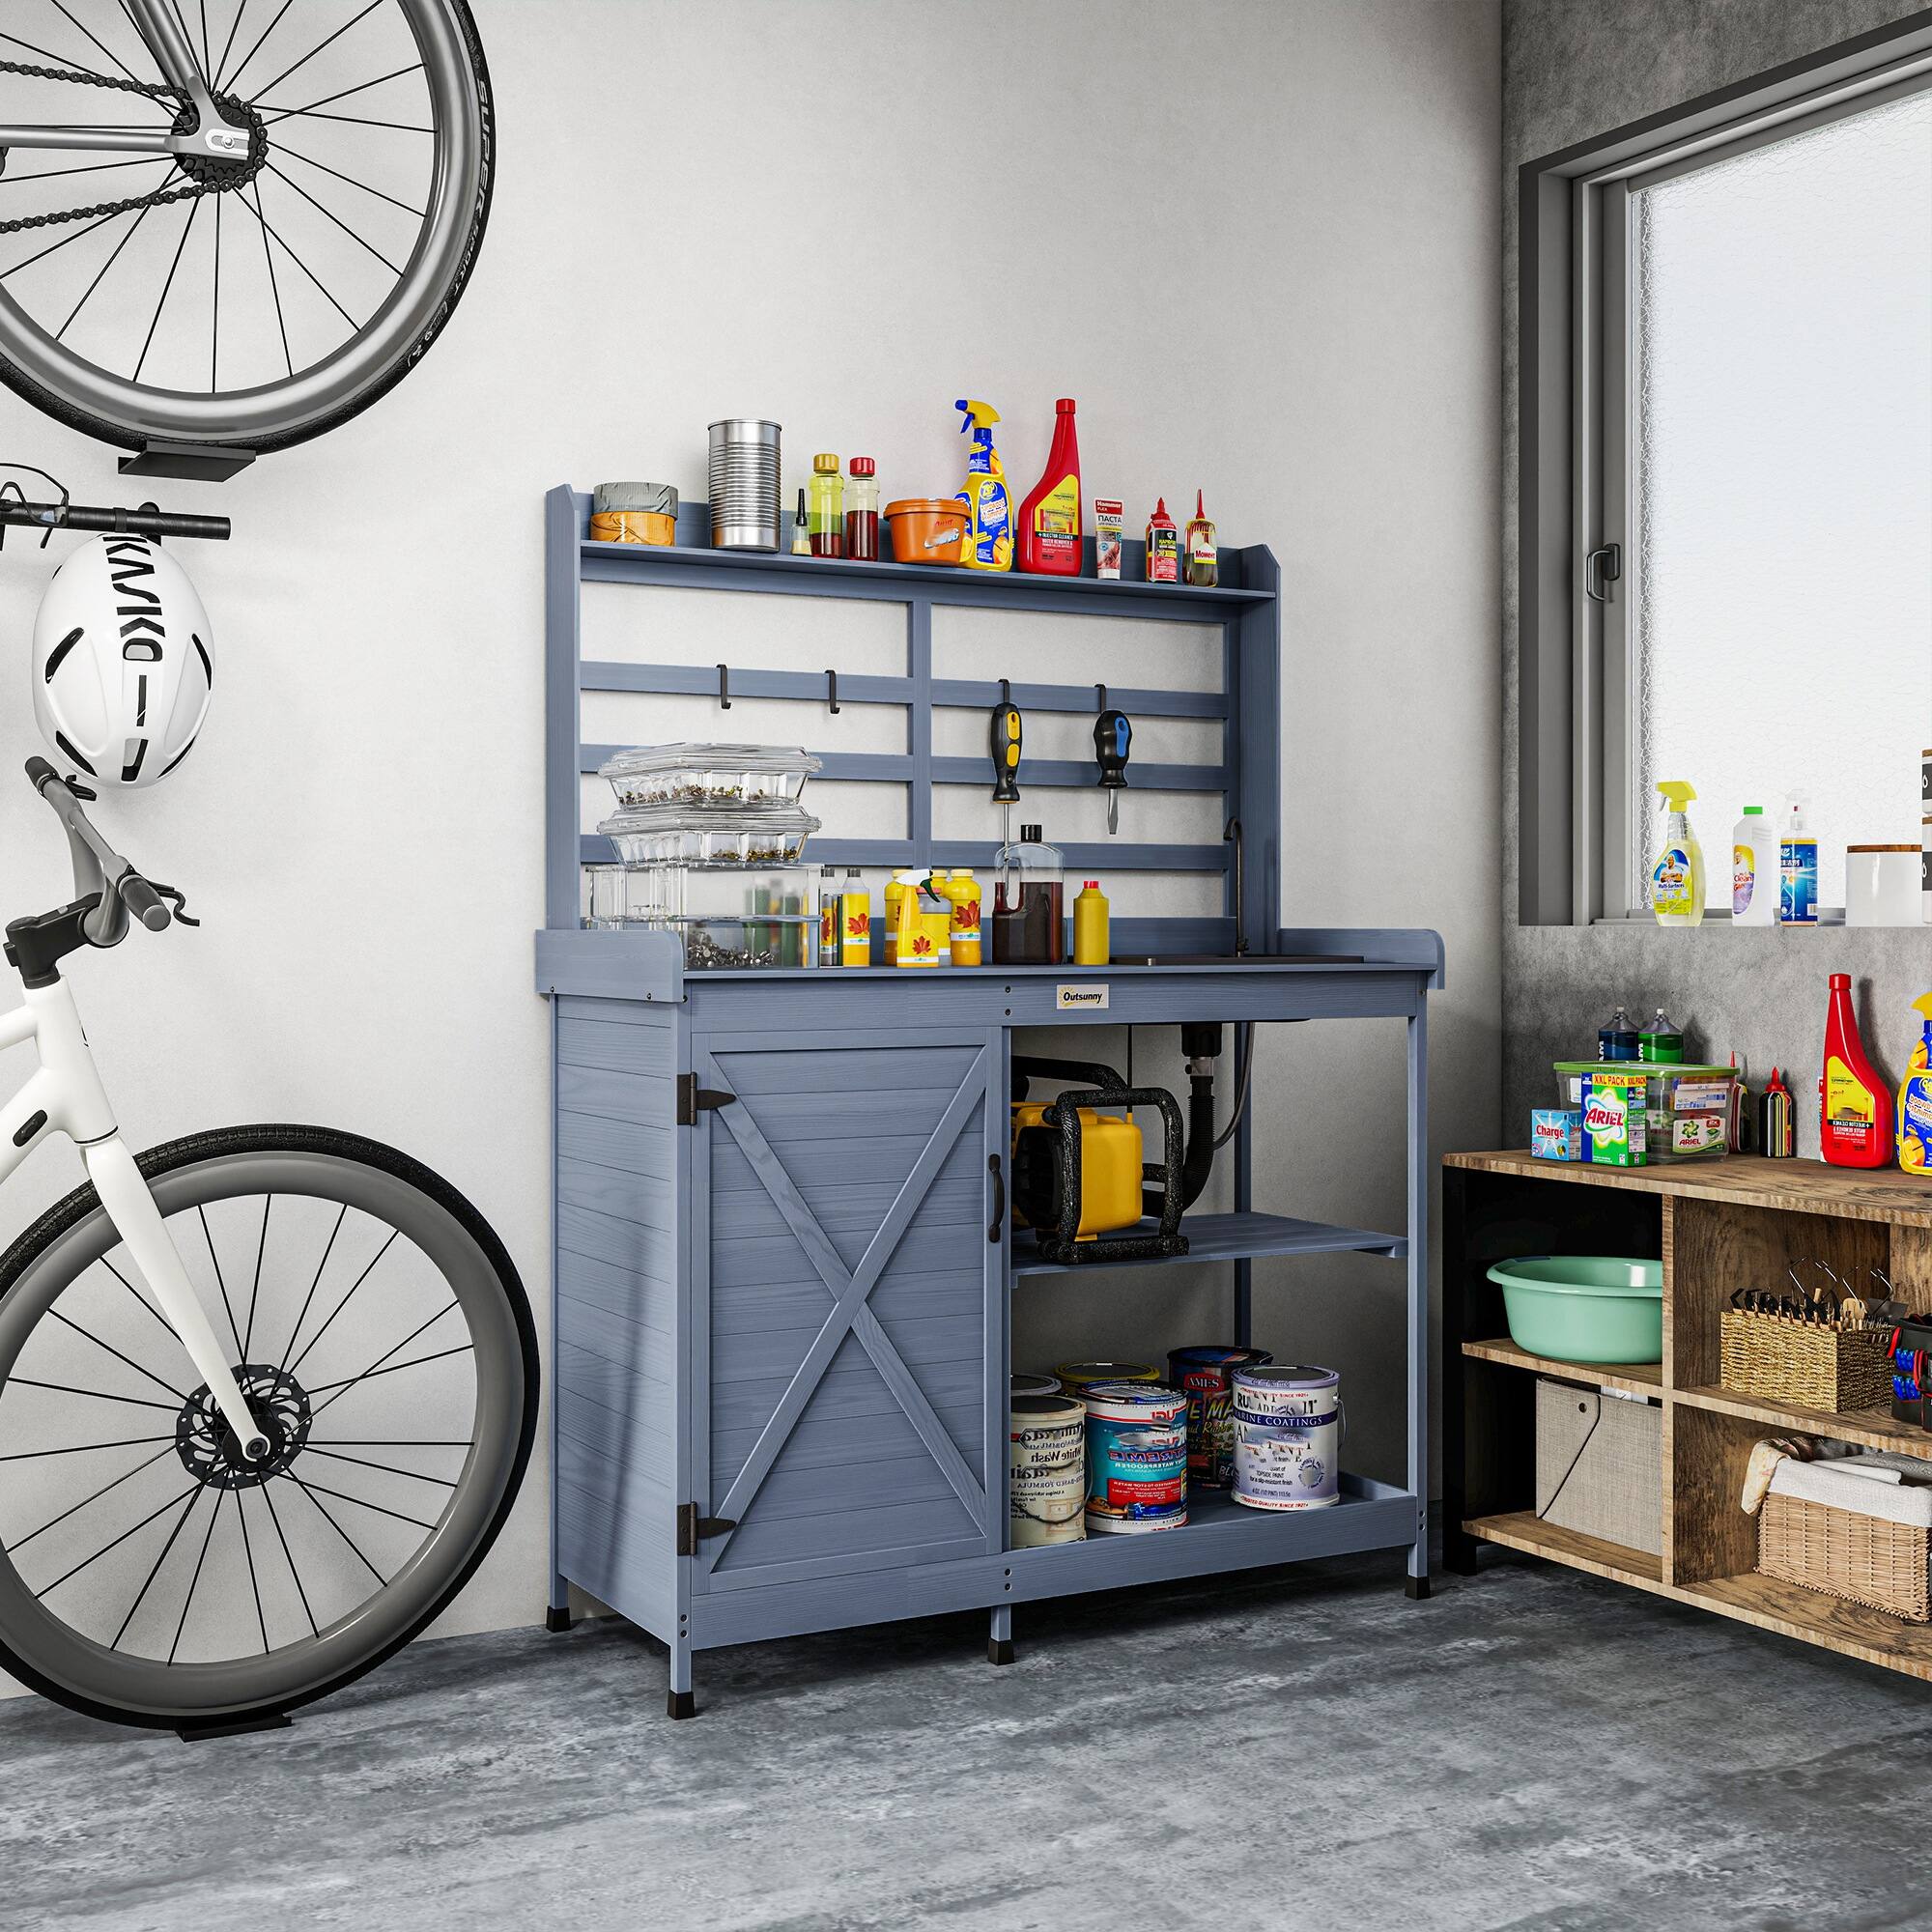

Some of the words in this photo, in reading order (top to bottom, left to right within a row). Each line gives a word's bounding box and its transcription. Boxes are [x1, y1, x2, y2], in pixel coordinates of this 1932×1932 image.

[476, 78, 491, 218] SUPER
[1097, 514, 1122, 524] ПАСТА
[1195, 550, 1216, 558] Момент
[102, 536, 166, 662] KASKO
[1063, 991, 1102, 1004] Outsunny
[1594, 1074, 1606, 1084] XXL
[1607, 1075, 1625, 1086] PACK
[1585, 1108, 1624, 1126] ARIEL
[1536, 1124, 1564, 1139] Charge
[1189, 1376, 1219, 1389] AMES
[1264, 1416, 1322, 1427] COATINGS
[1259, 1498, 1277, 1507] QUALITY
